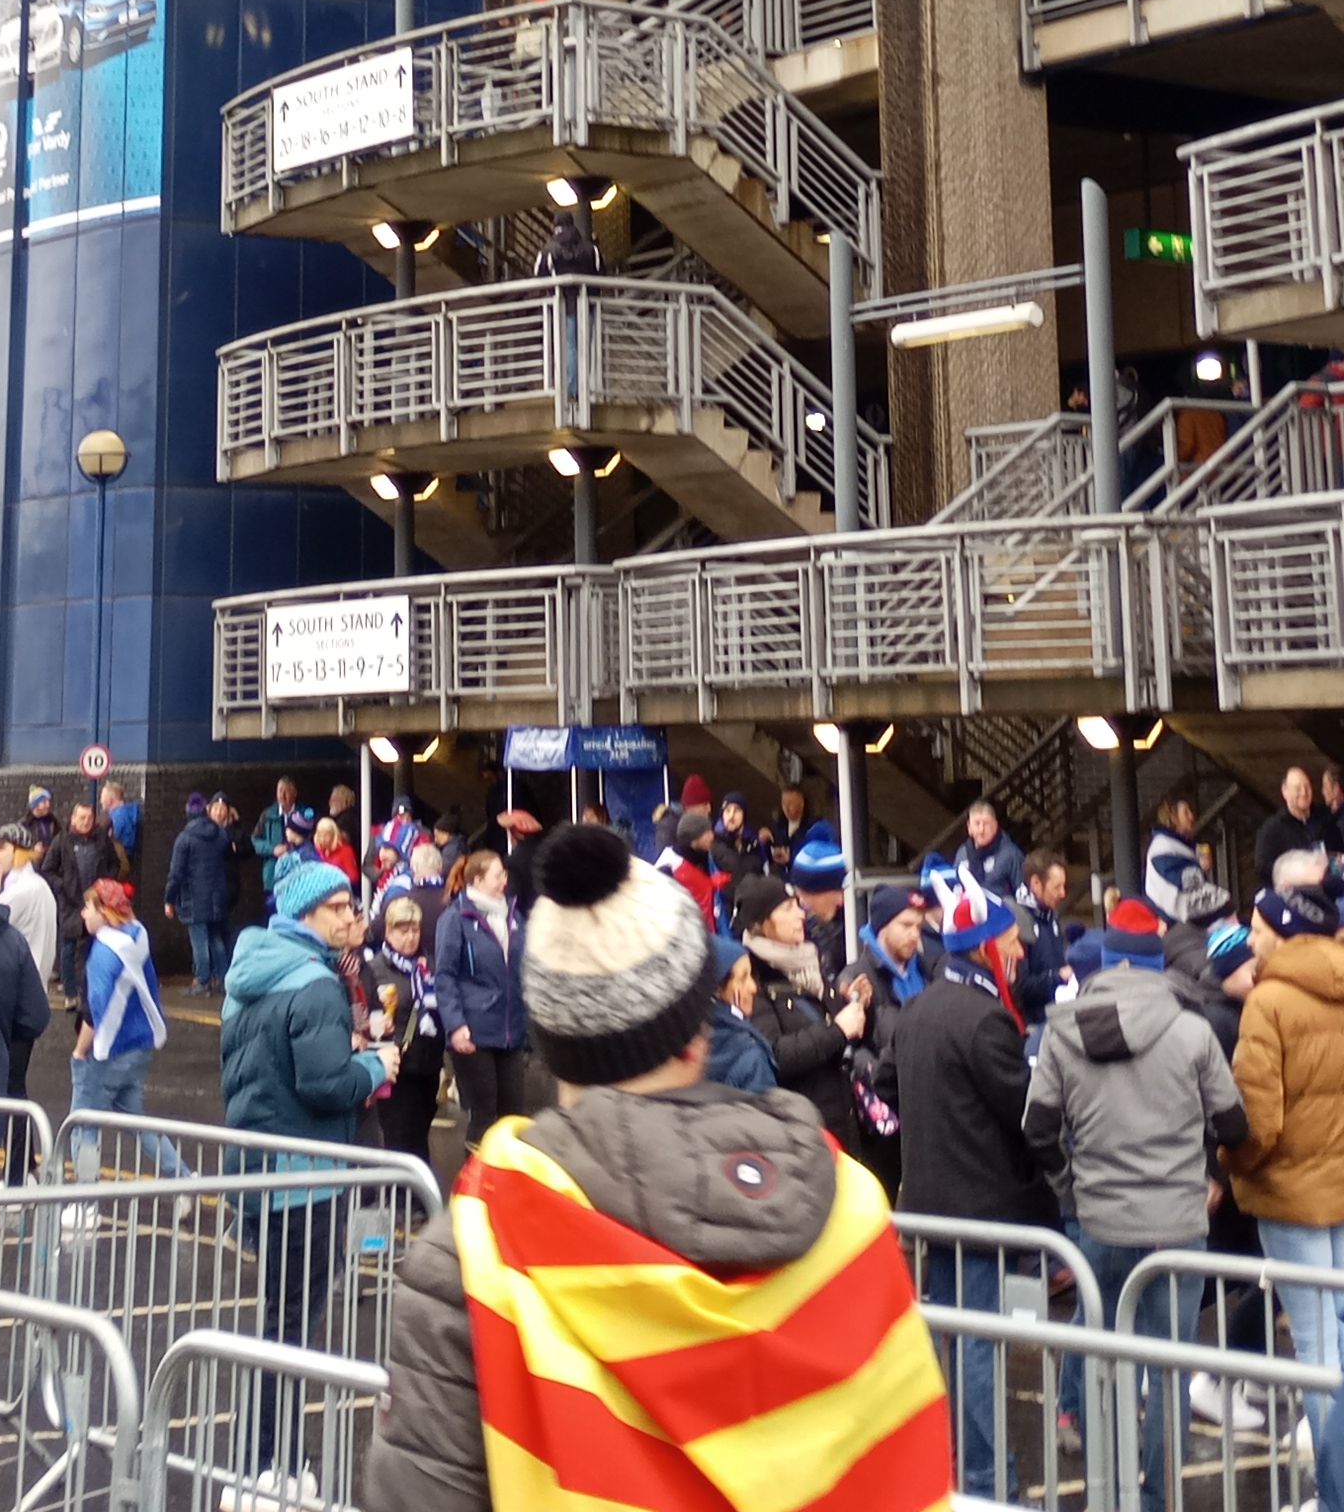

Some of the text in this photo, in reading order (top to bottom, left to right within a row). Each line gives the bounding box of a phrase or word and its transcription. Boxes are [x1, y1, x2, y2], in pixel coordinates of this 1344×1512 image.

[295, 85, 340, 111] SOUTH
[346, 68, 389, 95] STAND
[288, 611, 384, 637] SOUTH STAND
[316, 638, 355, 650] SECTIONS
[88, 755, 104, 768] 10
